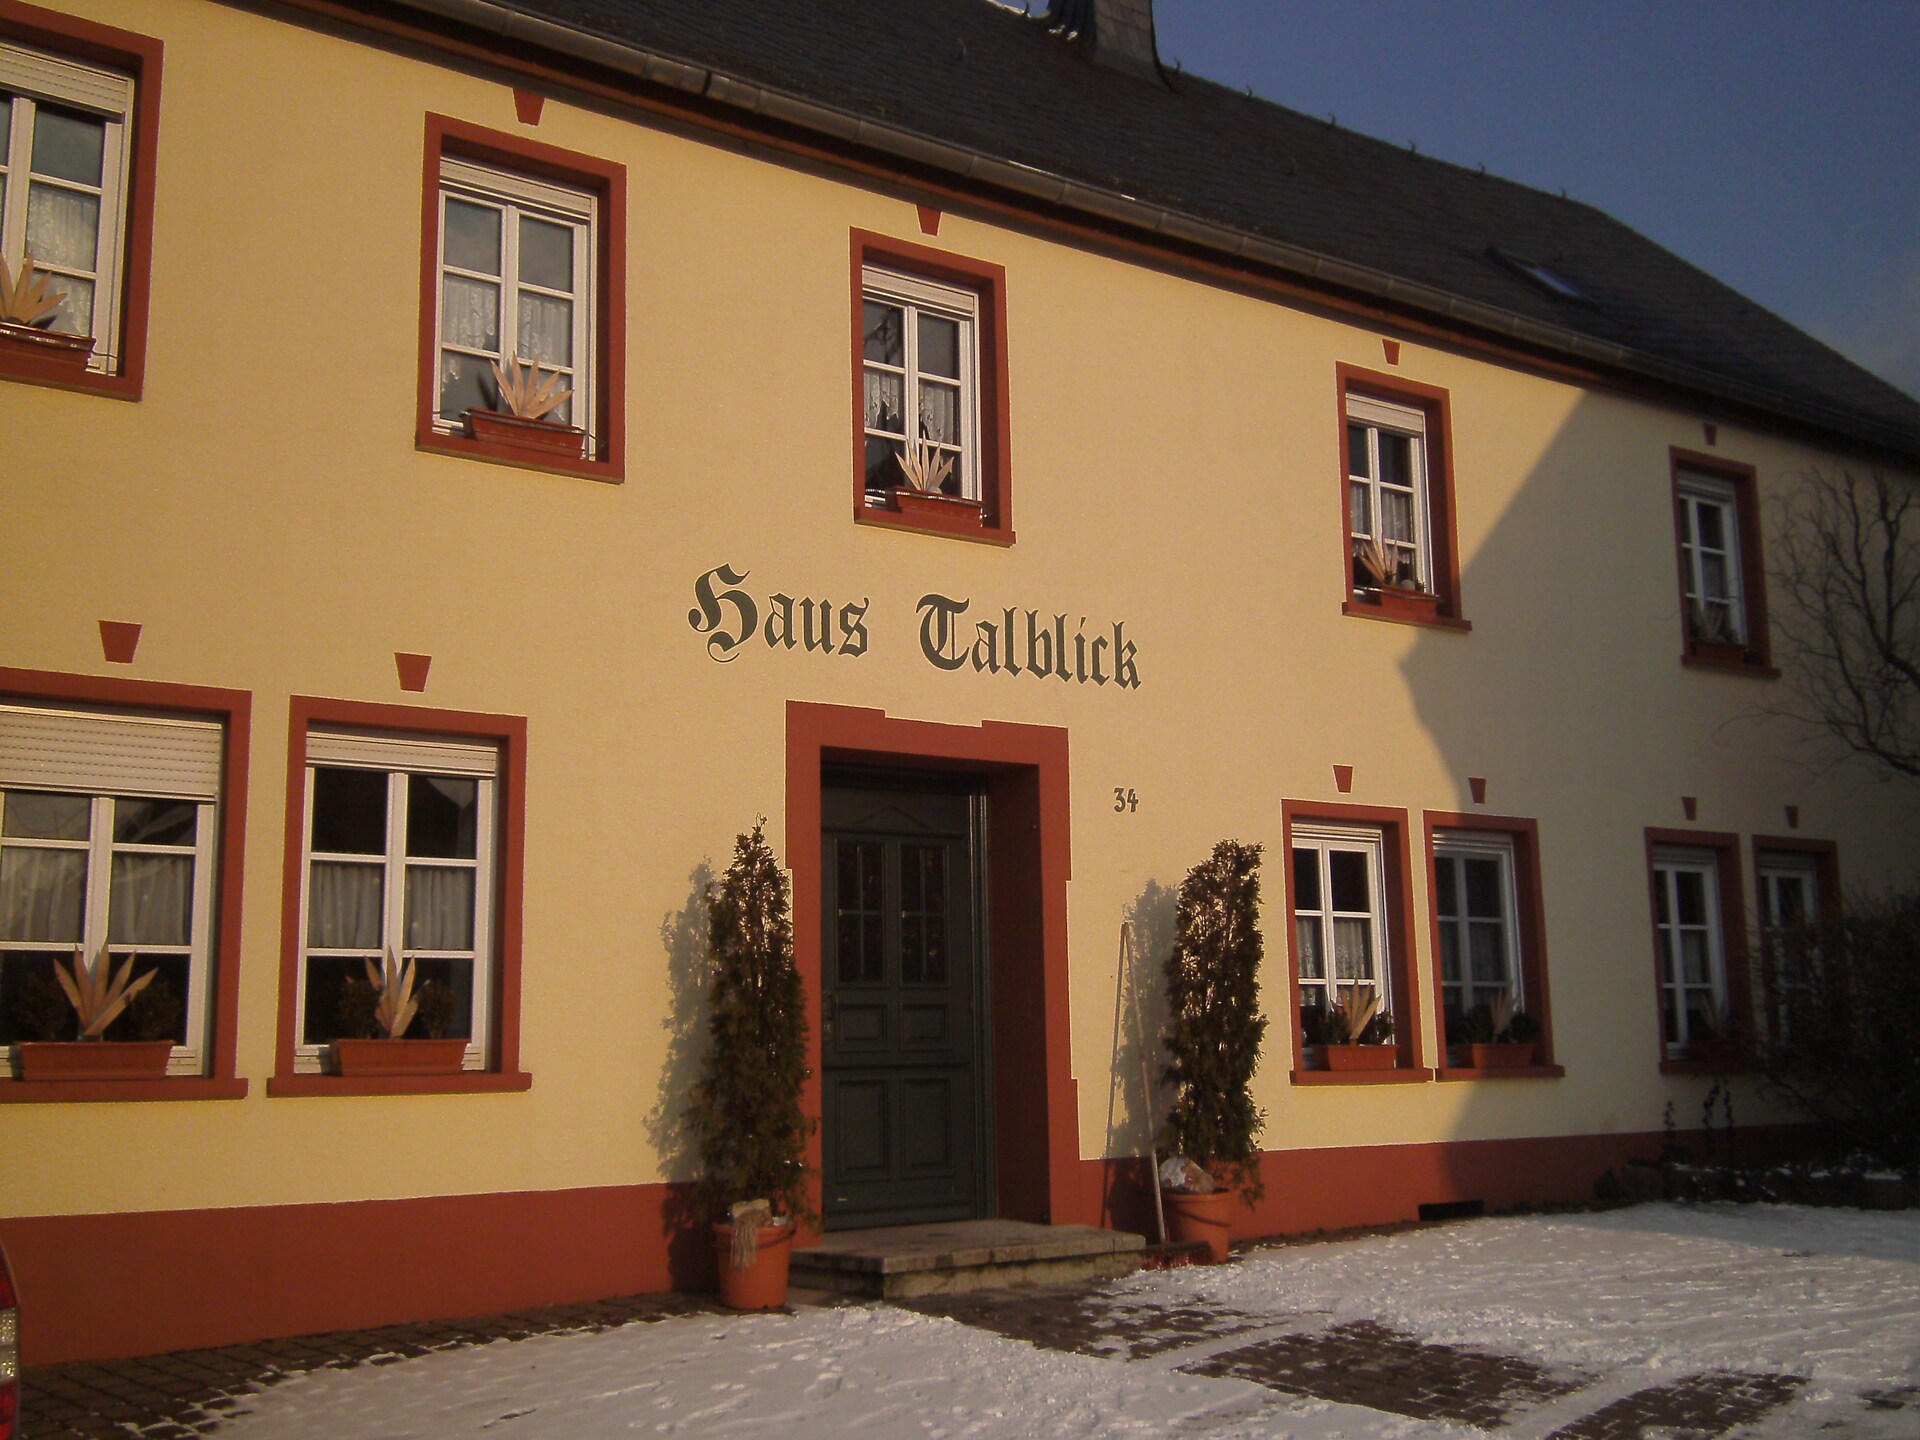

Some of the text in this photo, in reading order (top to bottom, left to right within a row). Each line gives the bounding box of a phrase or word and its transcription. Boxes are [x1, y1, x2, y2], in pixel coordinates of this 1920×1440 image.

[687, 563, 1142, 690] Haus Talblick
[1113, 787, 1139, 813] 34
